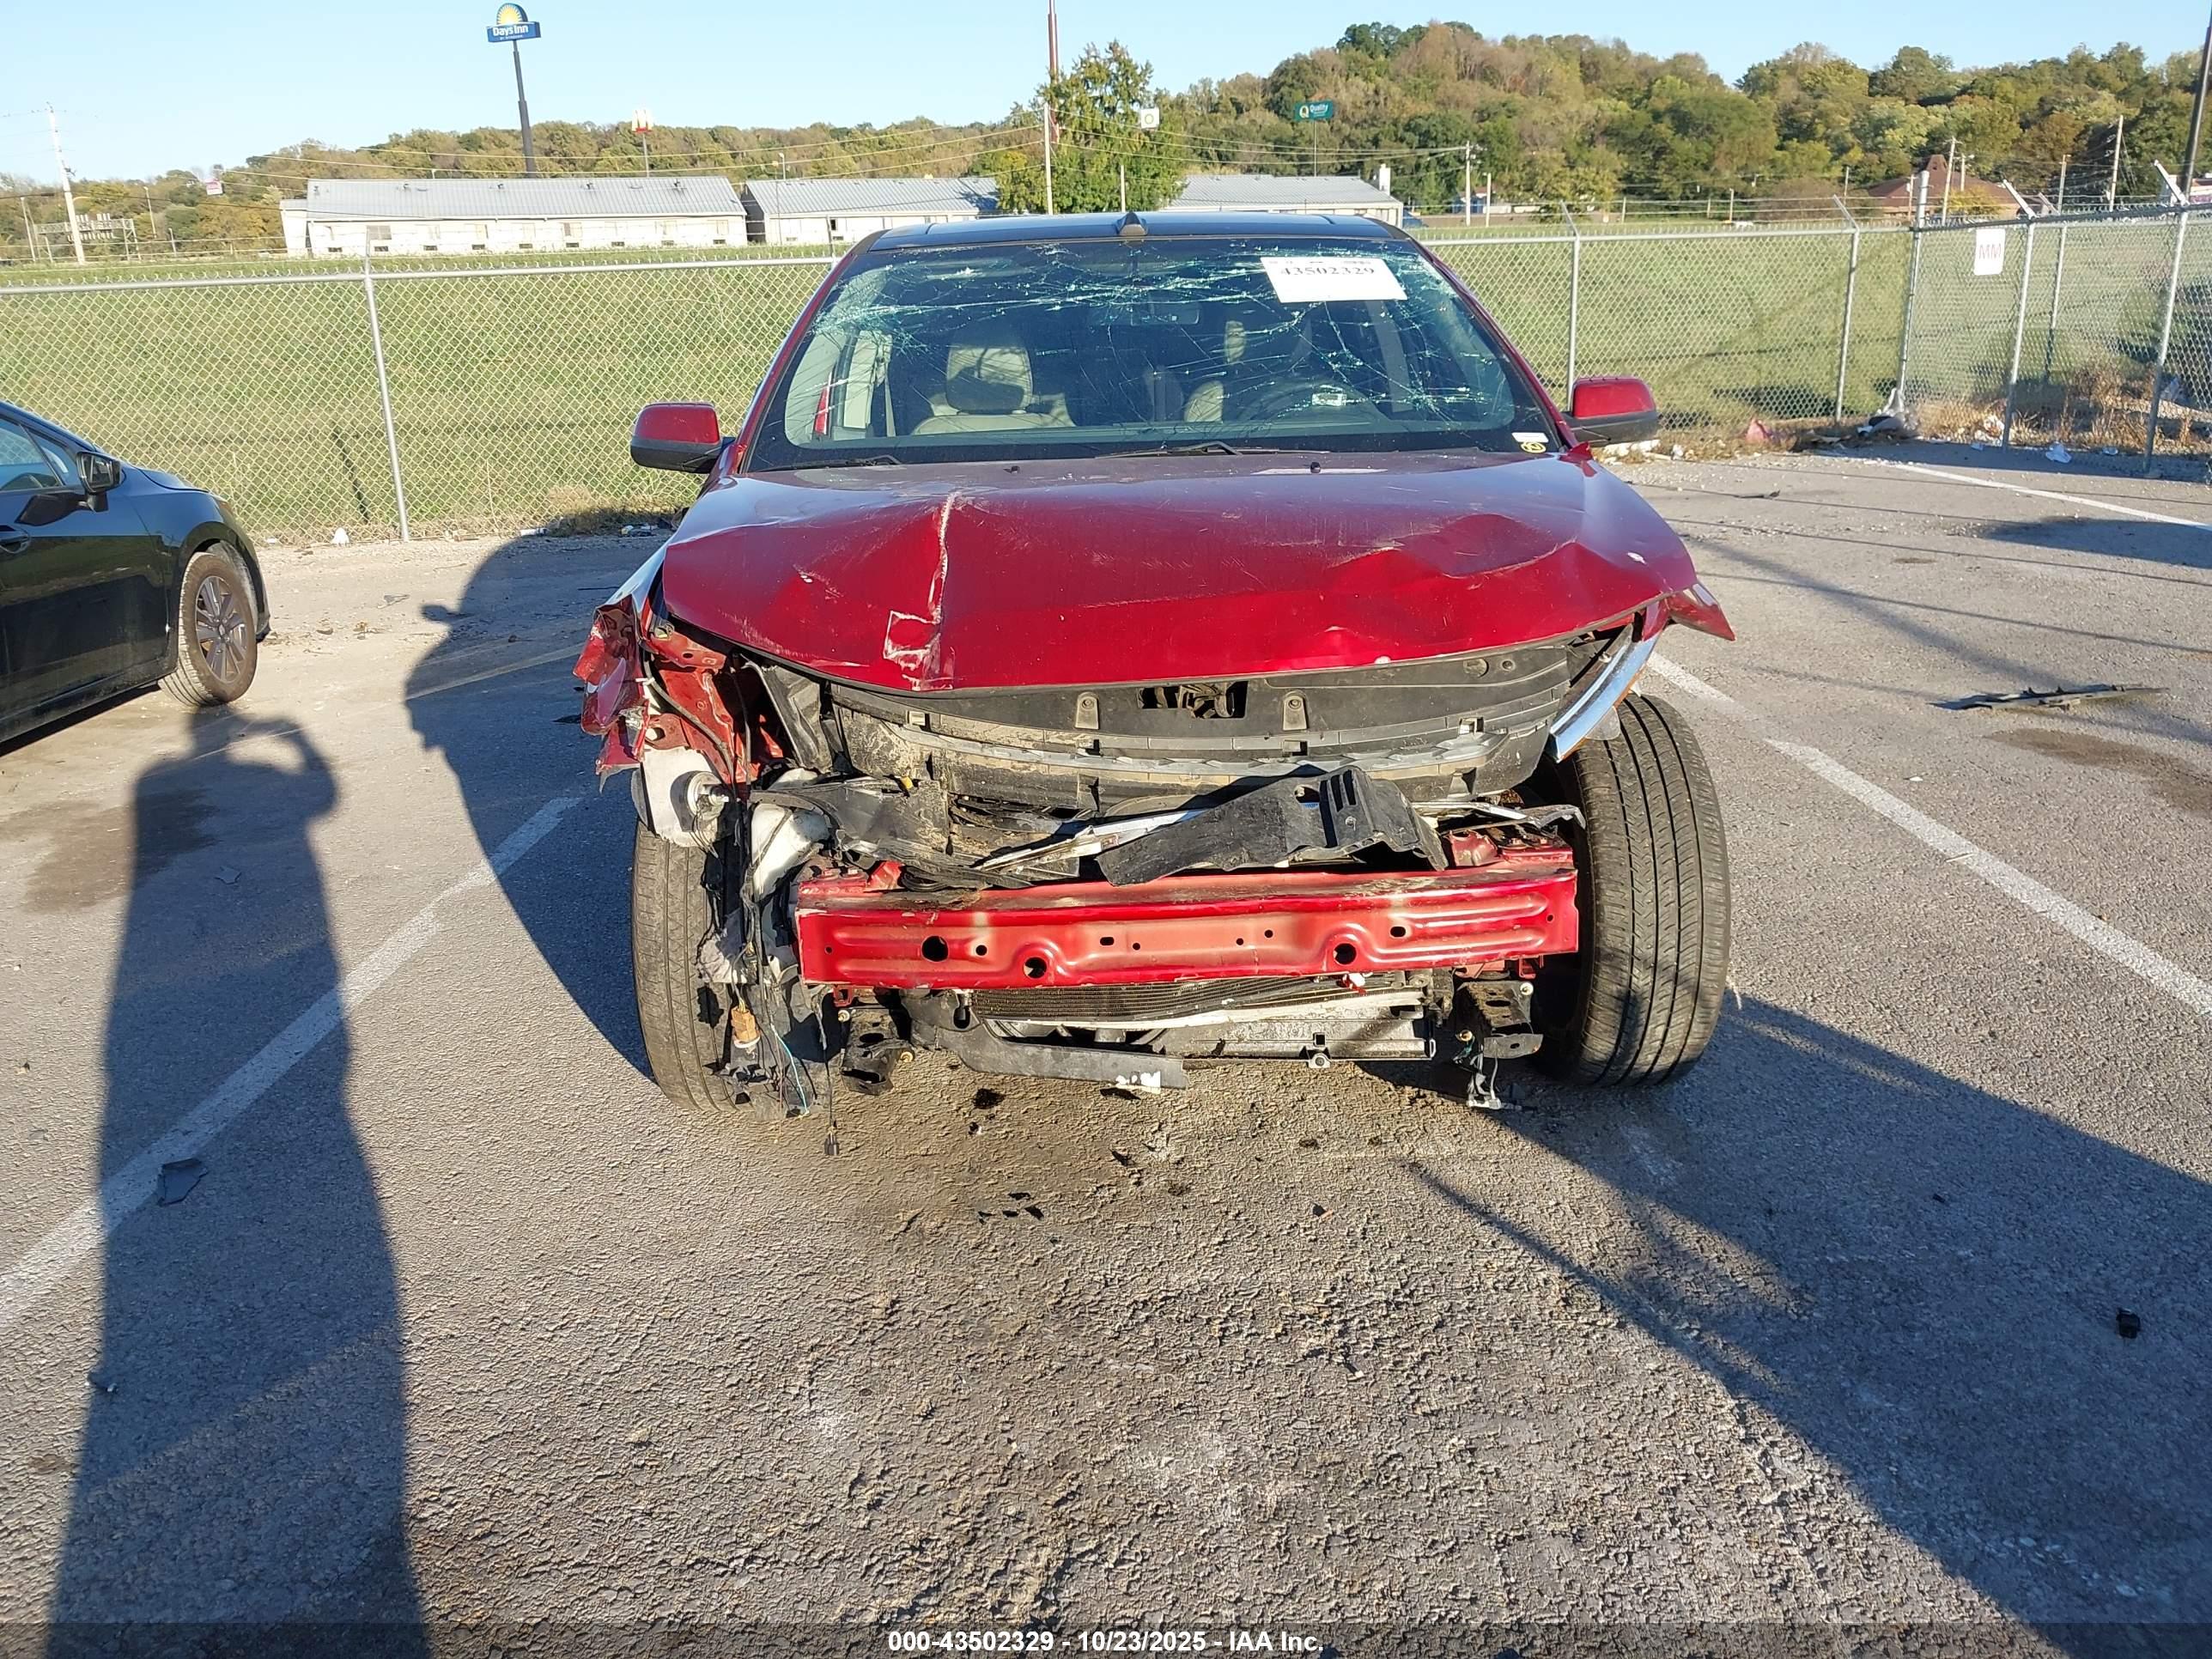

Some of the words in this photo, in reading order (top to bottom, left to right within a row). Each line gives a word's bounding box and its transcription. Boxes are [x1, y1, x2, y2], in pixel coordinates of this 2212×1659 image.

[492, 27, 514, 36] Days
[514, 25, 529, 33] Inn
[1280, 267, 1375, 276] 43502329
